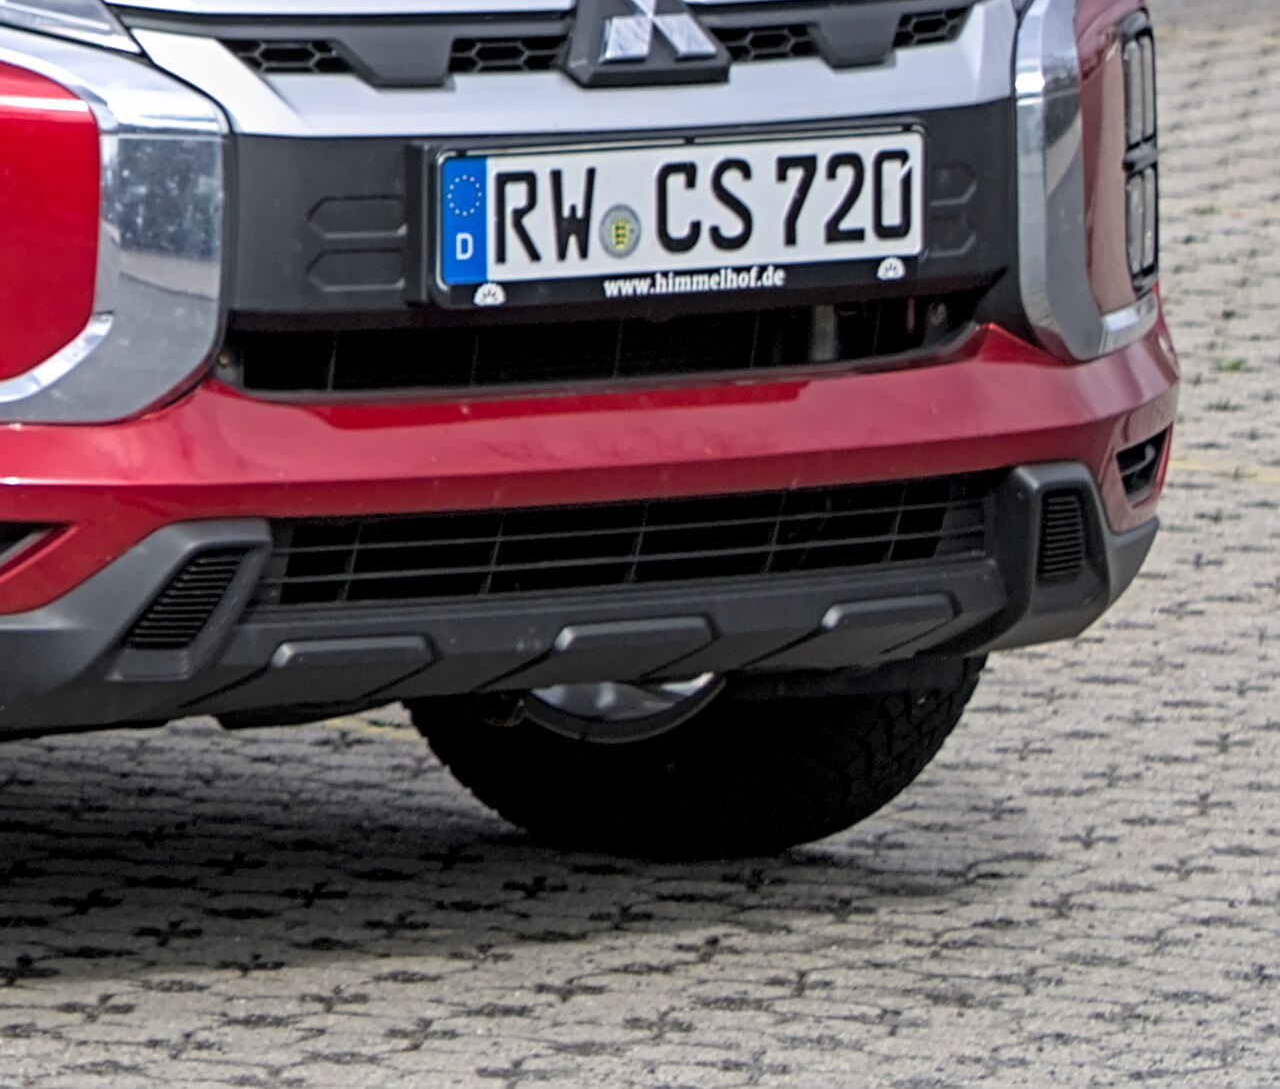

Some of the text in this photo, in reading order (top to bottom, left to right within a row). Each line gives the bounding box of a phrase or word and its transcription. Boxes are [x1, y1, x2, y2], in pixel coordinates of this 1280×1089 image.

[494, 149, 913, 265] RW CS 720
[455, 232, 474, 261] D
[603, 265, 786, 298] www.himmelhof.de
